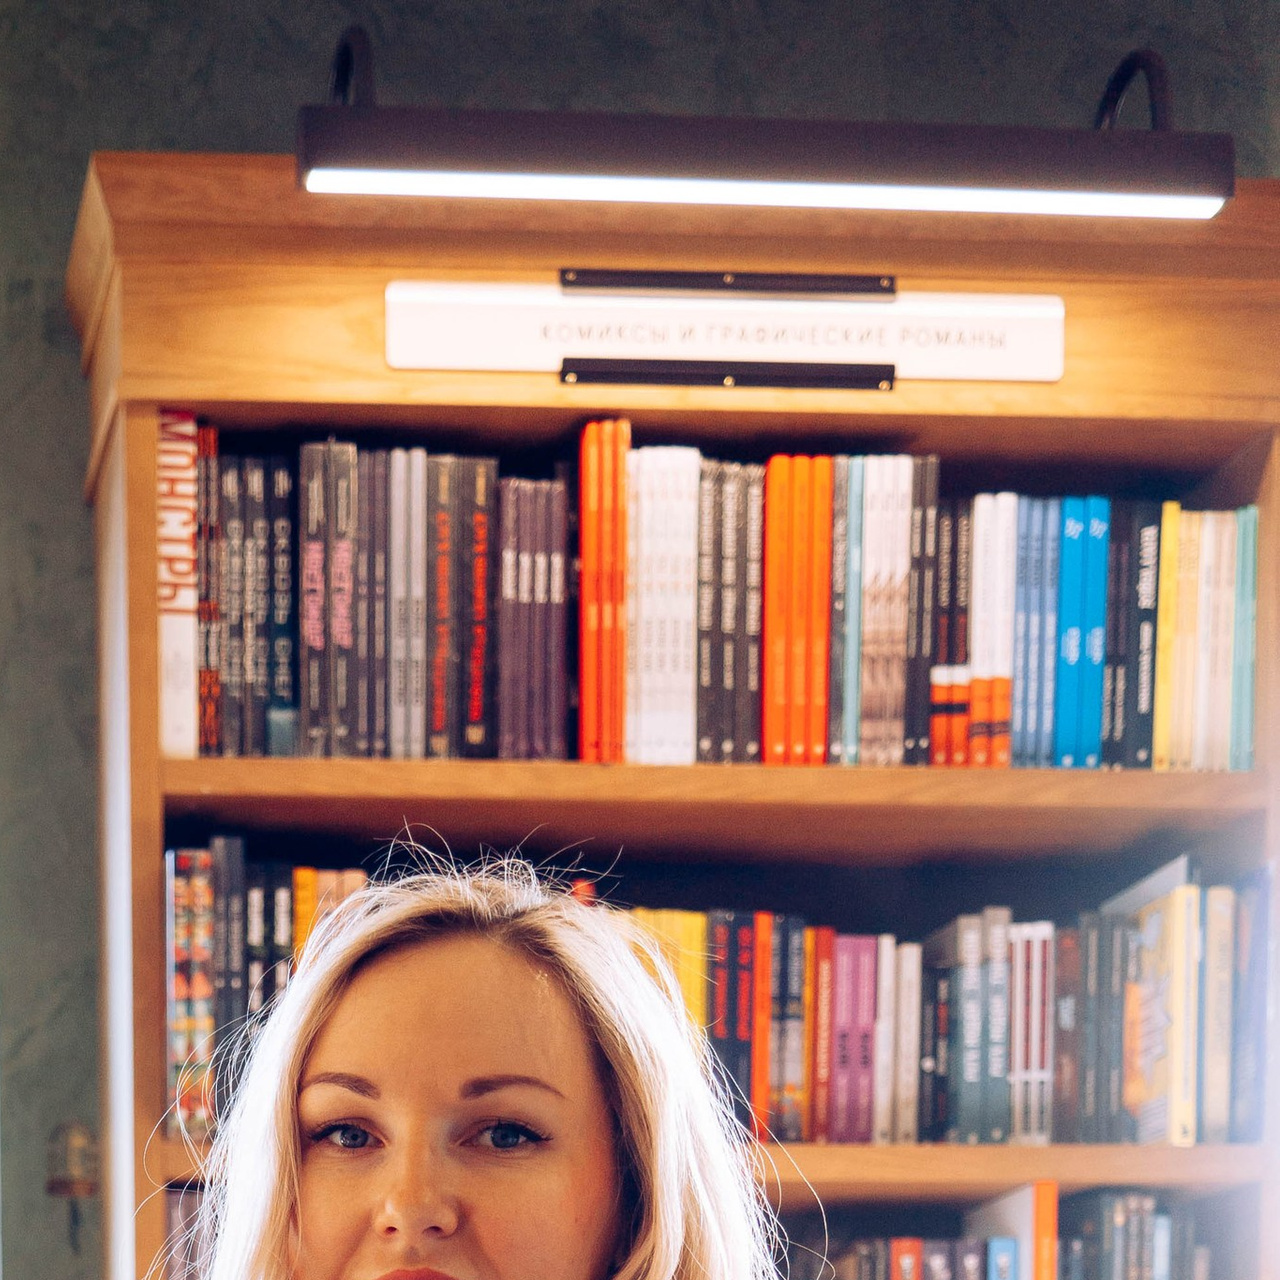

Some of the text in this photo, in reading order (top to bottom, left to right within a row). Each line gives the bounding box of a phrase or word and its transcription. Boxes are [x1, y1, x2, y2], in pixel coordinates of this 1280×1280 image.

[539, 323, 1007, 350] КОМИКСЫ И ГРАФИЧЕСКИЕ РОМАНЫ
[158, 413, 198, 614] МОНСТРЫ
